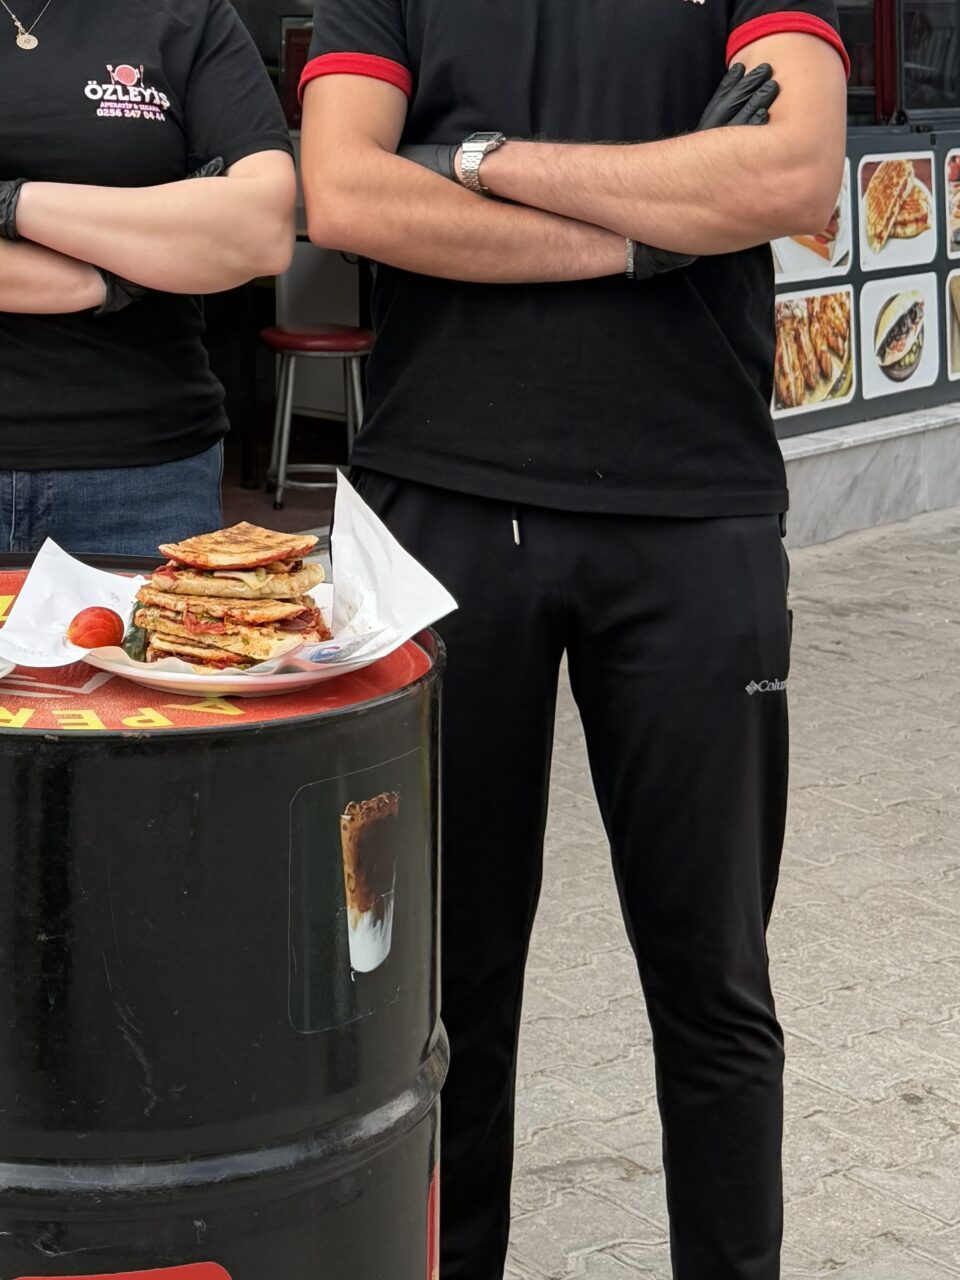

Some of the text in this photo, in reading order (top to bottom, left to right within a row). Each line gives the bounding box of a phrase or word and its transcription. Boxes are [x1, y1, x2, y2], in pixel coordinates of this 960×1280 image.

[84, 80, 170, 110] ÖZLEYİŞ
[97, 109, 122, 117] 0256
[124, 110, 141, 118] 247
